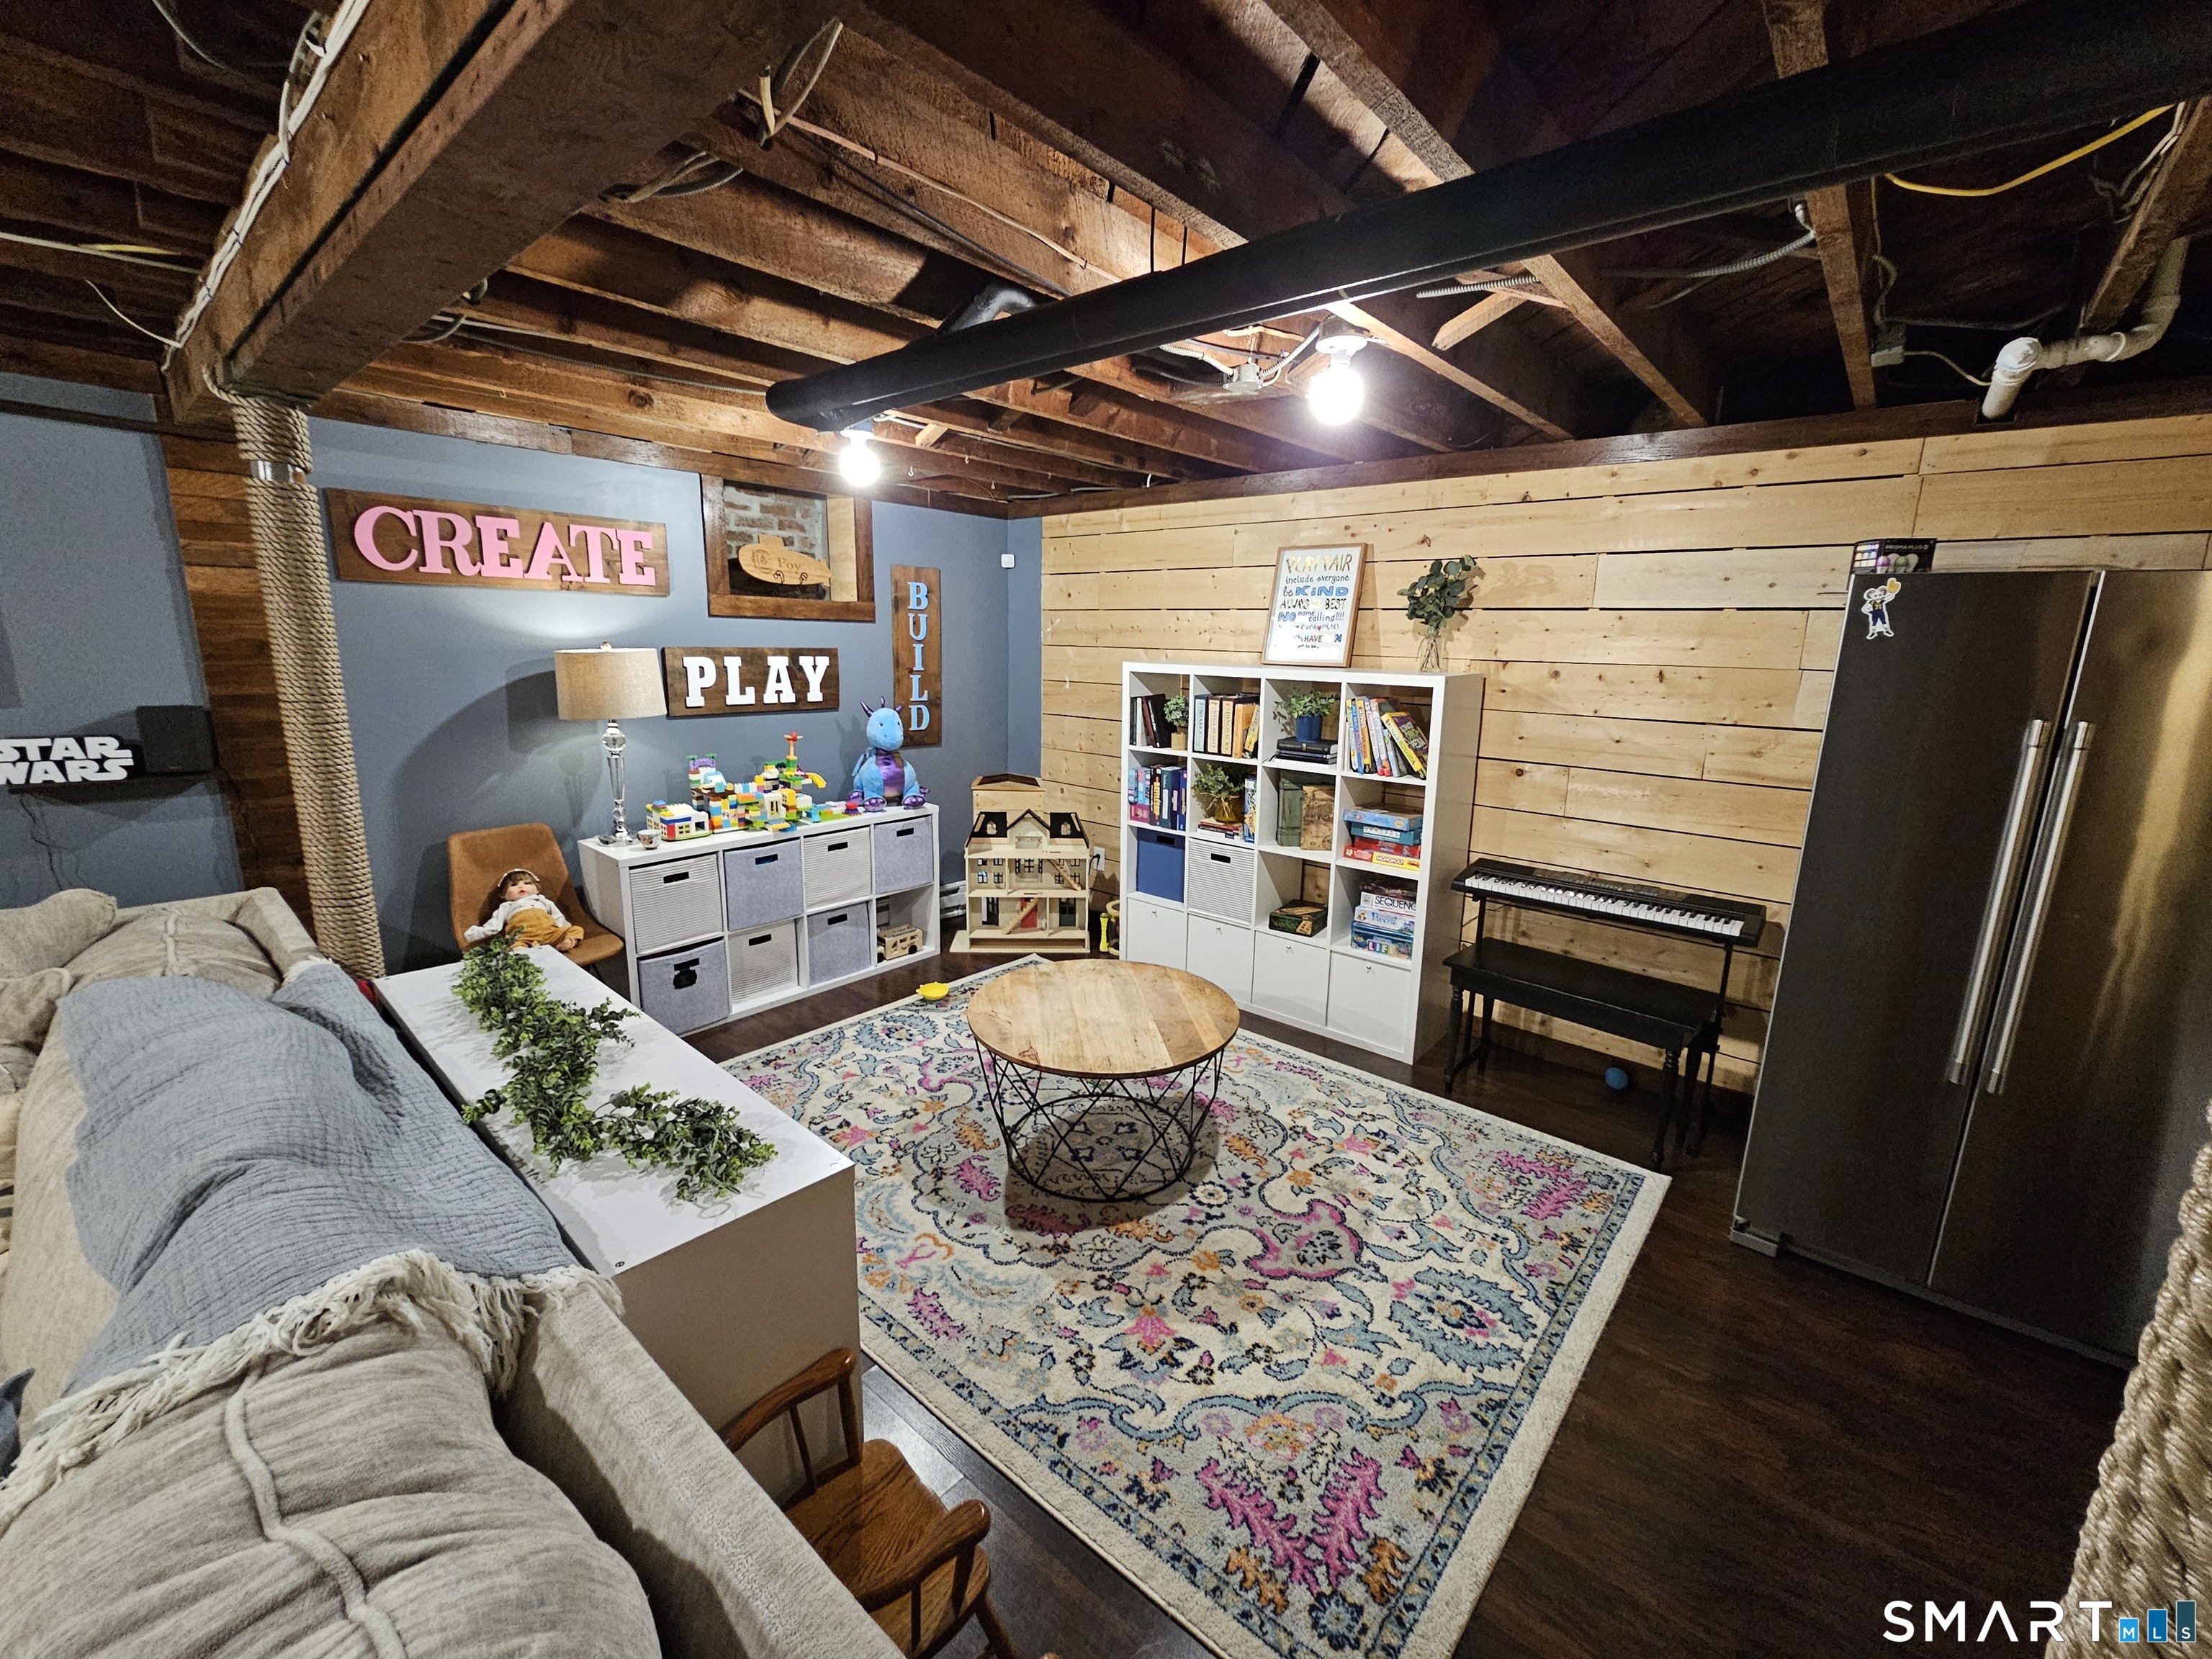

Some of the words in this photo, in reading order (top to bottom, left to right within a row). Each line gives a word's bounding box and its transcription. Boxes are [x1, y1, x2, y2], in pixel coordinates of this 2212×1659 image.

[354, 505, 656, 586] CREATE
[778, 557, 801, 575] Foy
[1322, 554, 1353, 572] FAIR
[1285, 575, 1314, 585] include
[1316, 575, 1350, 584] everyone
[1283, 585, 1293, 597] be
[1277, 611, 1297, 621] NO
[907, 581, 930, 732] BUILD
[683, 656, 830, 708] PLAY
[1376, 855, 1404, 866] MONOPOLY
[1375, 895, 1416, 912] SEQUENC
[1368, 940, 1397, 956] LIFE
